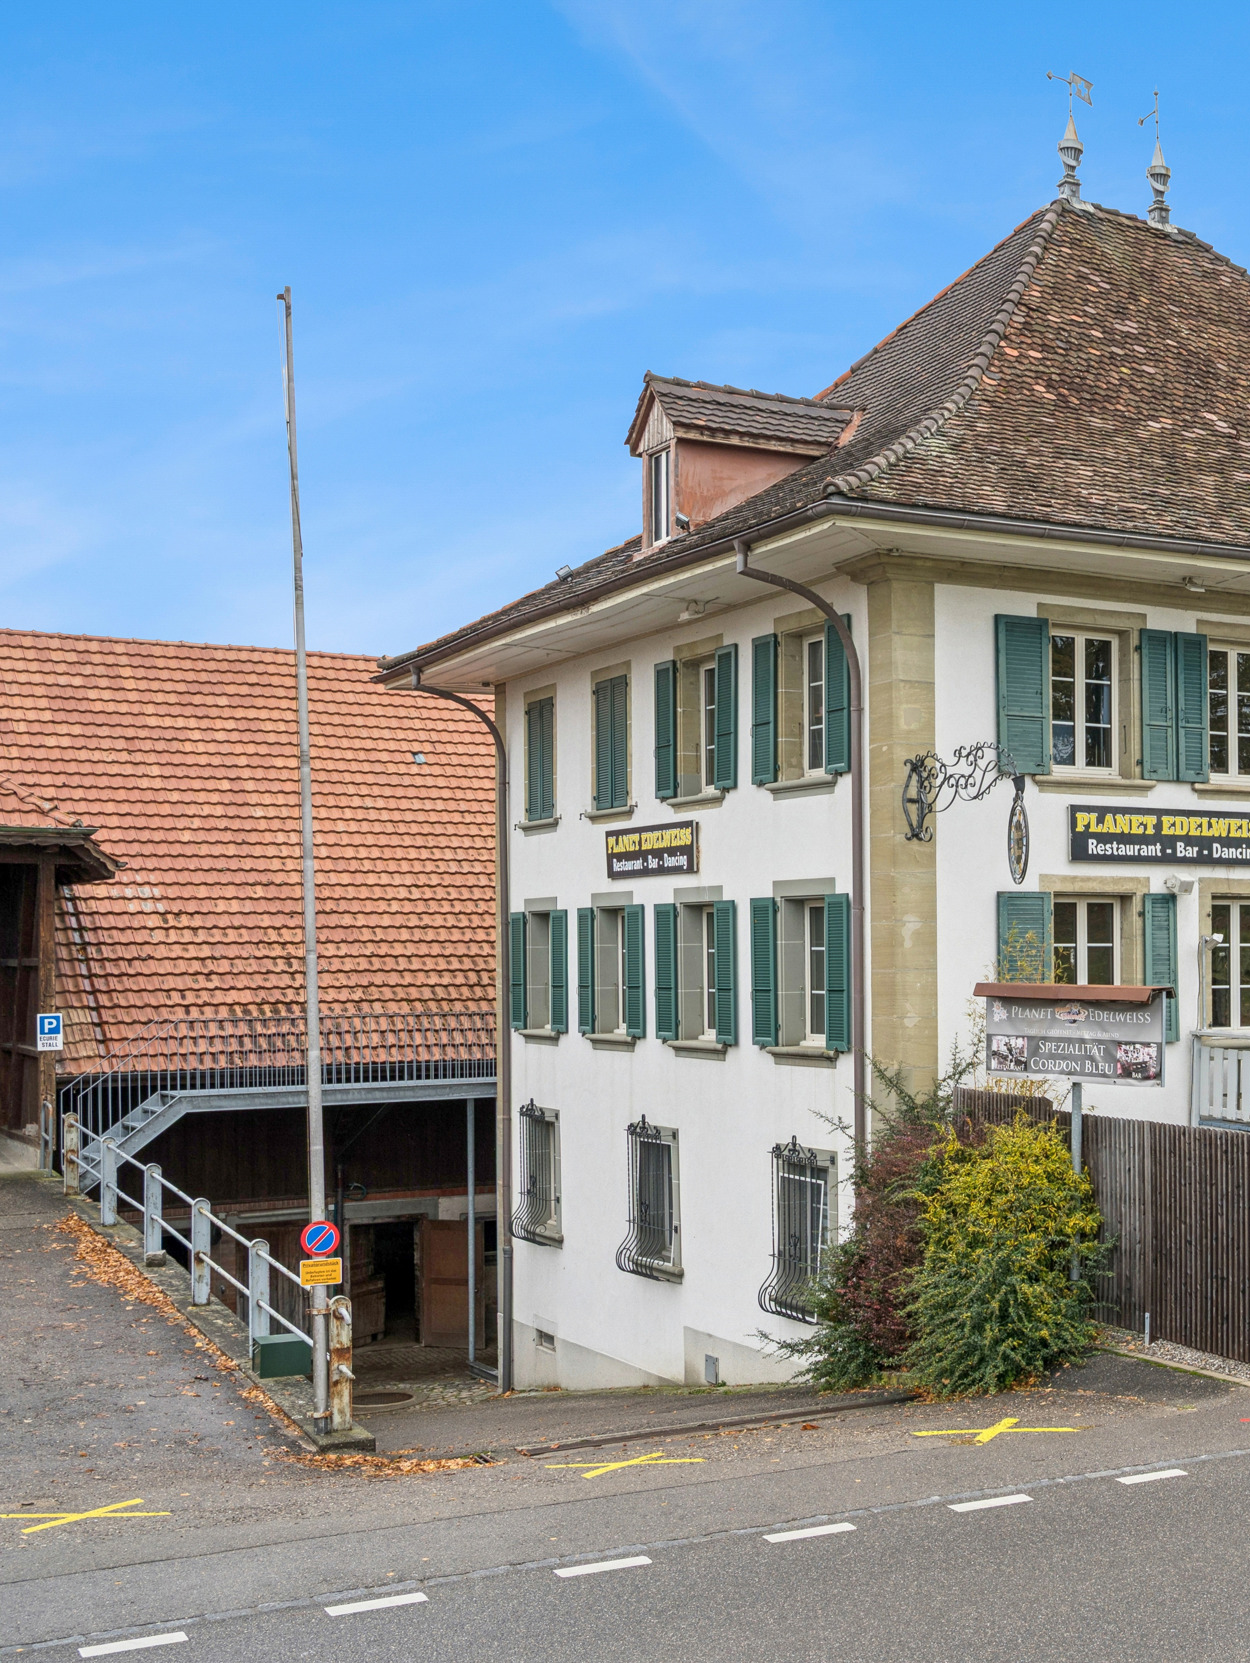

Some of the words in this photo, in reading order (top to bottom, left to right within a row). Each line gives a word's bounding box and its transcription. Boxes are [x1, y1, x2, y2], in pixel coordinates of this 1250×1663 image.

[1075, 812, 1157, 834] PLANET
[607, 833, 640, 854] PLANET
[640, 827, 692, 850] EDELWEISS
[1088, 838, 1162, 856] Restaurant
[1176, 842, 1198, 858] Bar
[613, 857, 643, 872] Restaurant
[648, 855, 658, 869] Bar
[664, 852, 687, 869] Dancing
[1011, 1005, 1053, 1019] PLANET
[1089, 1008, 1151, 1024] EDELWEISS
[44, 1019, 57, 1033] P
[1038, 1040, 1106, 1056] SPEZIALITÄT
[1030, 1057, 1081, 1073] CORDON
[1085, 1060, 1114, 1075] BLEU
[1132, 1071, 1142, 1079] BAR
